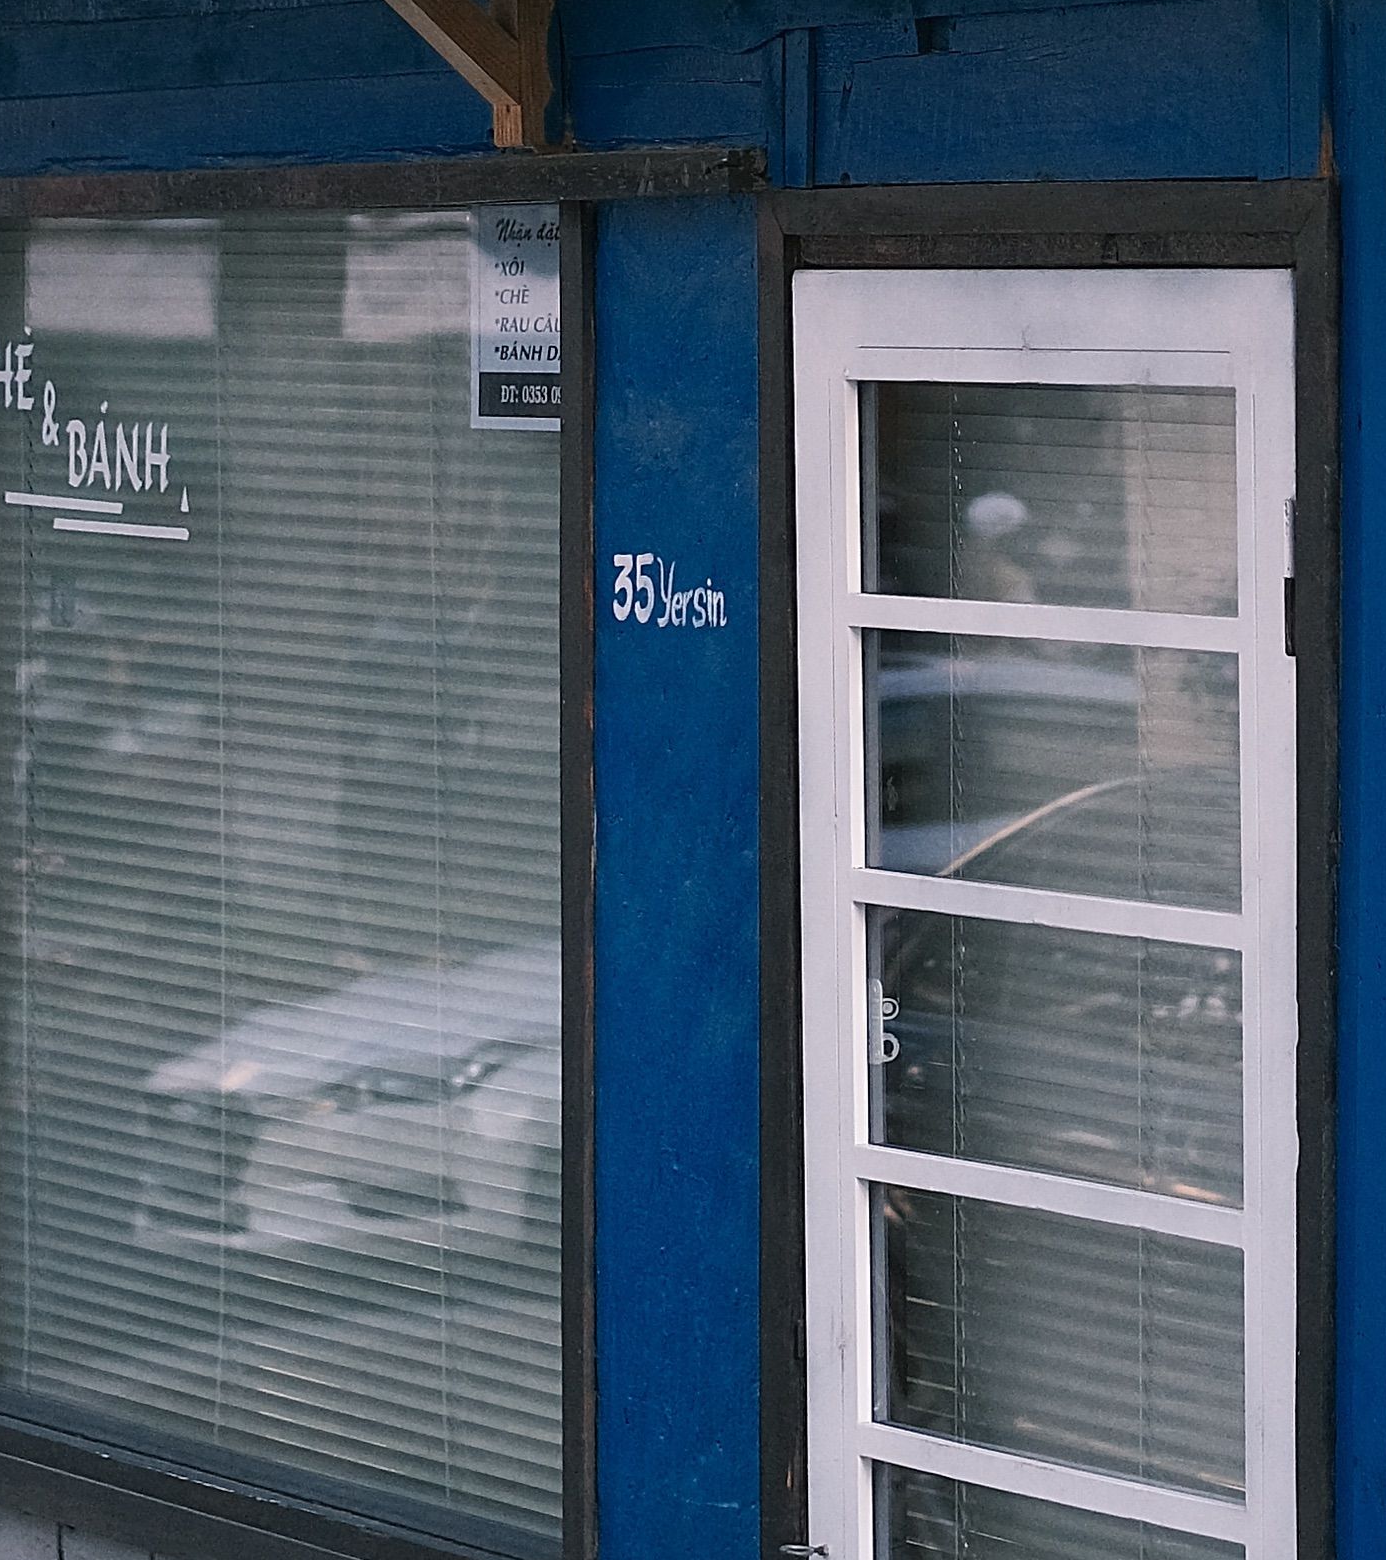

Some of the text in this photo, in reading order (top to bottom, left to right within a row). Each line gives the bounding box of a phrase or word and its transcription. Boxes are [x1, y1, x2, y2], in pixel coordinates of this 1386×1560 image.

[496, 218, 532, 248] Nhận
[500, 256, 525, 277] XÔI
[500, 284, 530, 305] CHÈ
[500, 317, 530, 333] RAU
[499, 340, 561, 361] BÁNH D
[500, 385, 518, 403] ĐT:
[522, 385, 548, 404] 0353
[42, 380, 59, 446] &
[66, 400, 171, 493] BÁNH
[613, 552, 728, 628] 35 Yersin
